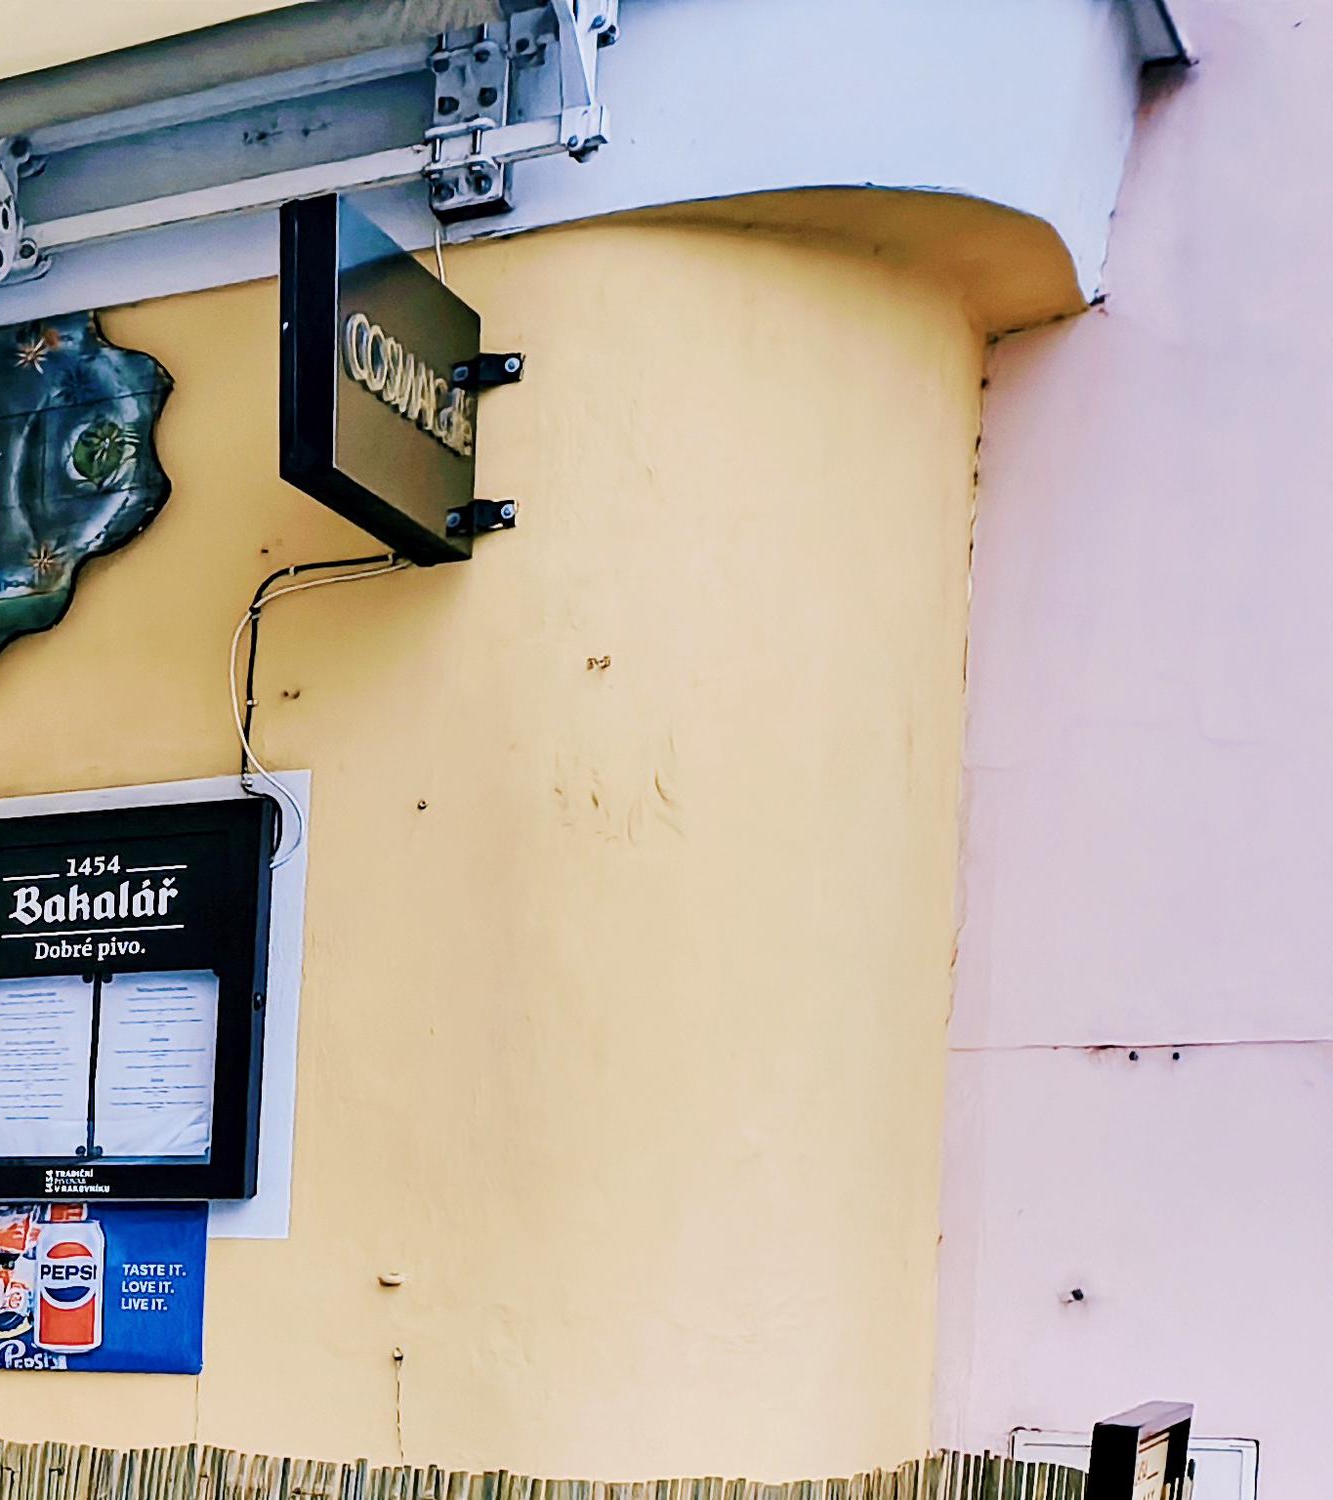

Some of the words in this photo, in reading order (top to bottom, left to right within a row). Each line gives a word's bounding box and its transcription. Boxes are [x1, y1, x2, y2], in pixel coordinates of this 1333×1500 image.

[66, 855, 121, 877] 1454
[8, 877, 179, 926] Bakalář
[34, 937, 93, 960] Dobré
[97, 936, 146, 961] pivo.
[40, 1264, 97, 1281] PEPSI
[122, 1264, 166, 1277] TASTE
[169, 1264, 187, 1277] IT.
[121, 1280, 156, 1294] LOVE
[158, 1280, 175, 1294] IT.
[121, 1297, 149, 1311] LIVE
[151, 1298, 168, 1311] IT.
